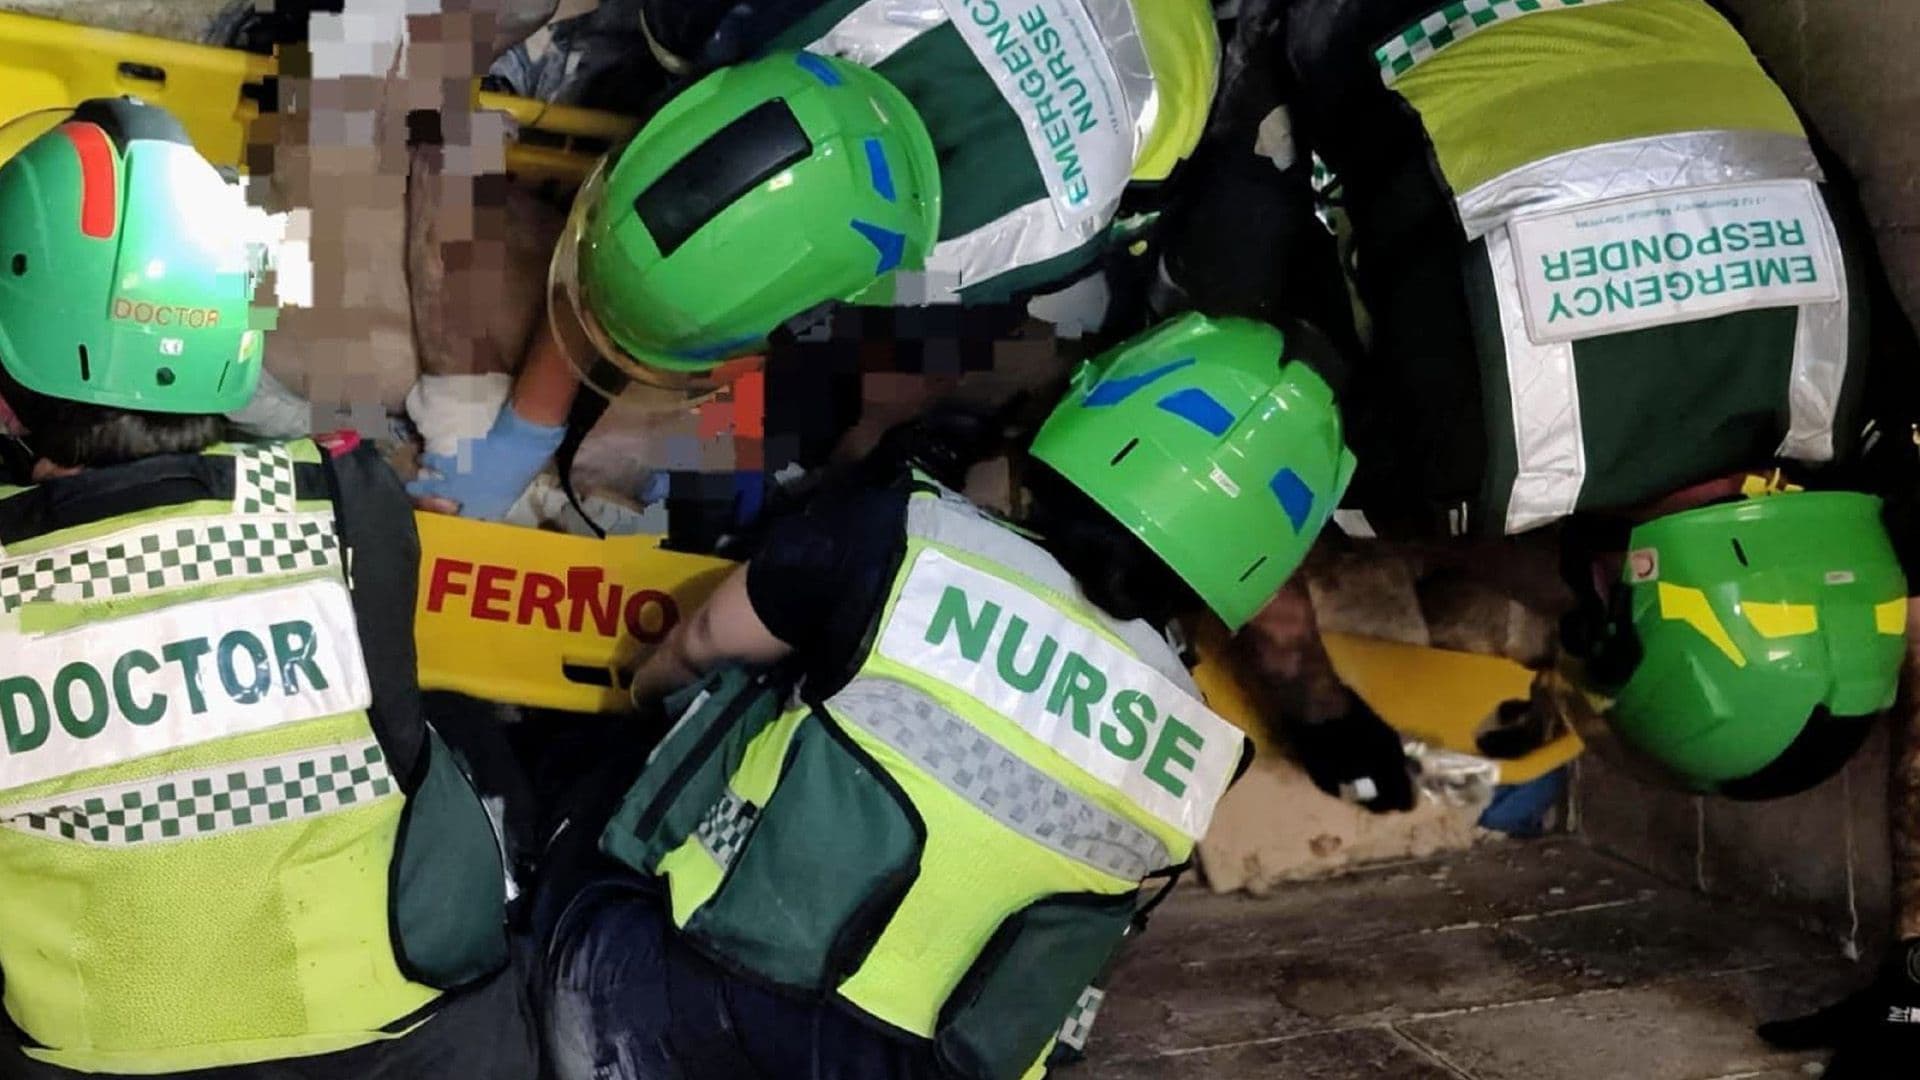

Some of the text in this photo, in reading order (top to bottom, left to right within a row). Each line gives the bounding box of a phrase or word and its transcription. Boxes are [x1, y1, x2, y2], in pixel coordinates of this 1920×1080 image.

[1018, 5, 1098, 134] NURSE
[1541, 218, 1806, 281] RESPONDER
[1546, 255, 1817, 323] EMERGENCY
[114, 299, 219, 329] DOCTOR
[426, 557, 680, 645] FERNO
[0, 619, 329, 754] DOCTOR
[924, 585, 1204, 799] NURSE
